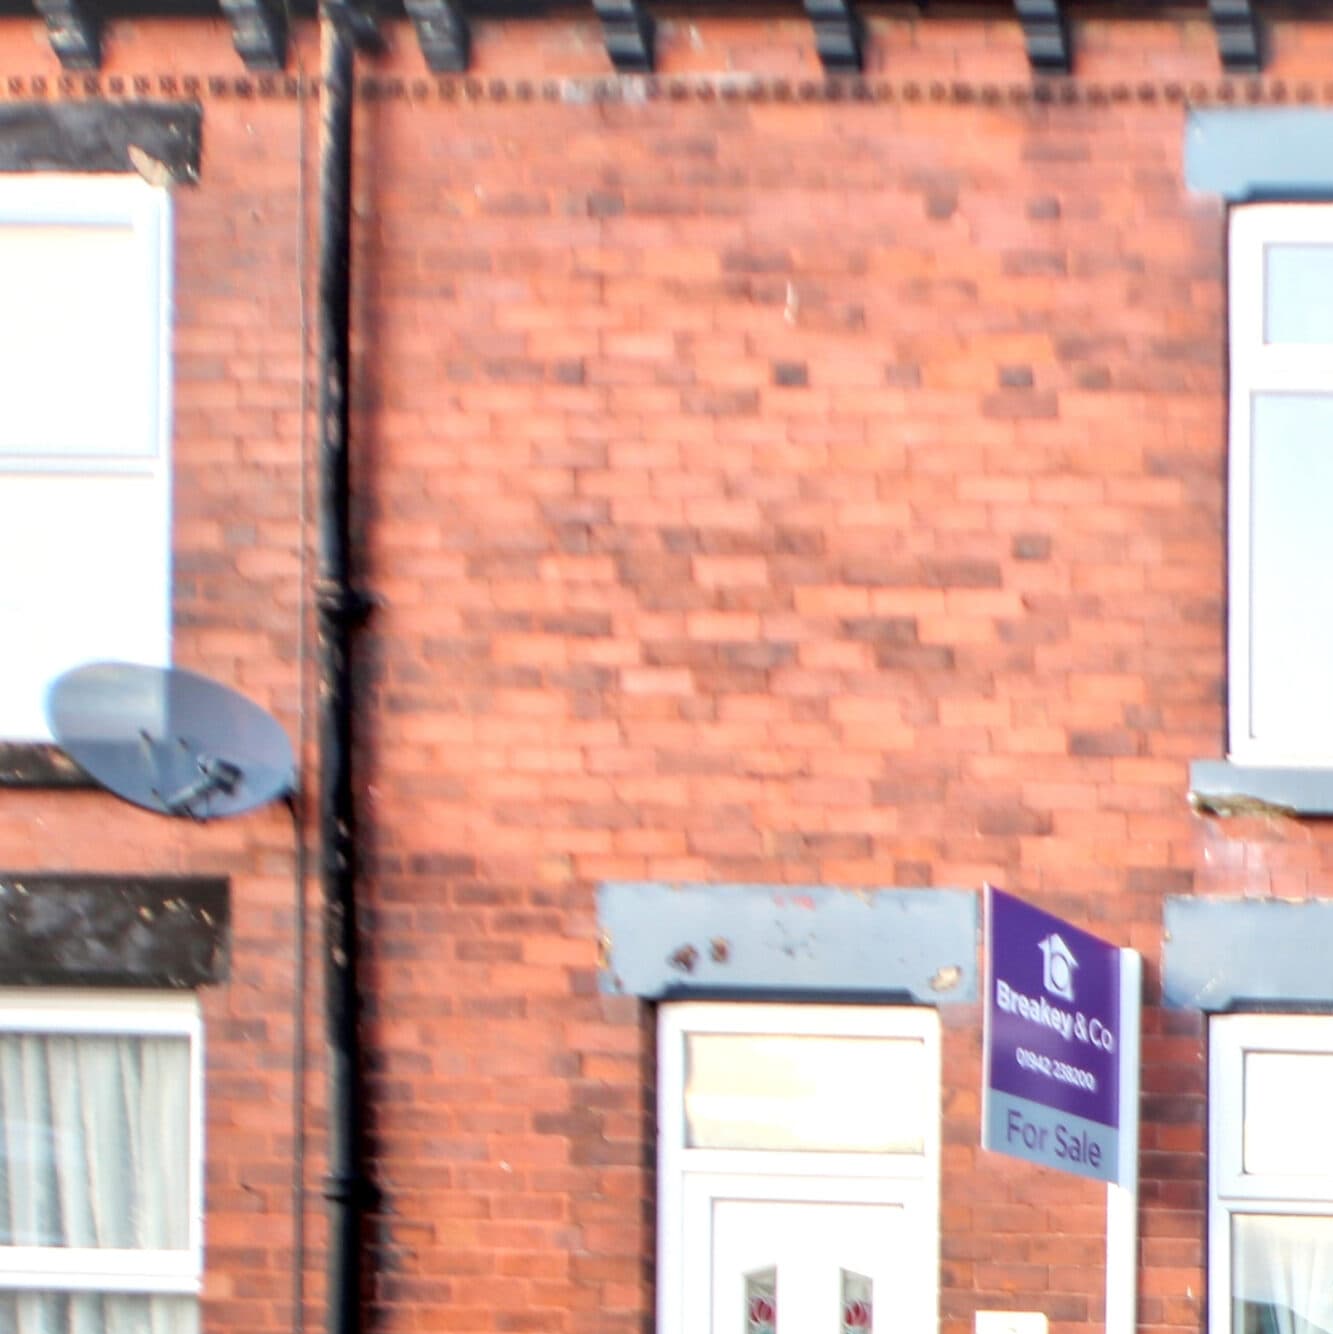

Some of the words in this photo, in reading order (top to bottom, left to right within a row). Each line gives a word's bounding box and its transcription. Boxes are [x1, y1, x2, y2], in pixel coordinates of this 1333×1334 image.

[996, 978, 1071, 1040] Breakey
[1074, 1012, 1088, 1043] &
[1089, 1017, 1114, 1053] Co
[1006, 1109, 1048, 1150] For
[1054, 1123, 1102, 1168] Sale
